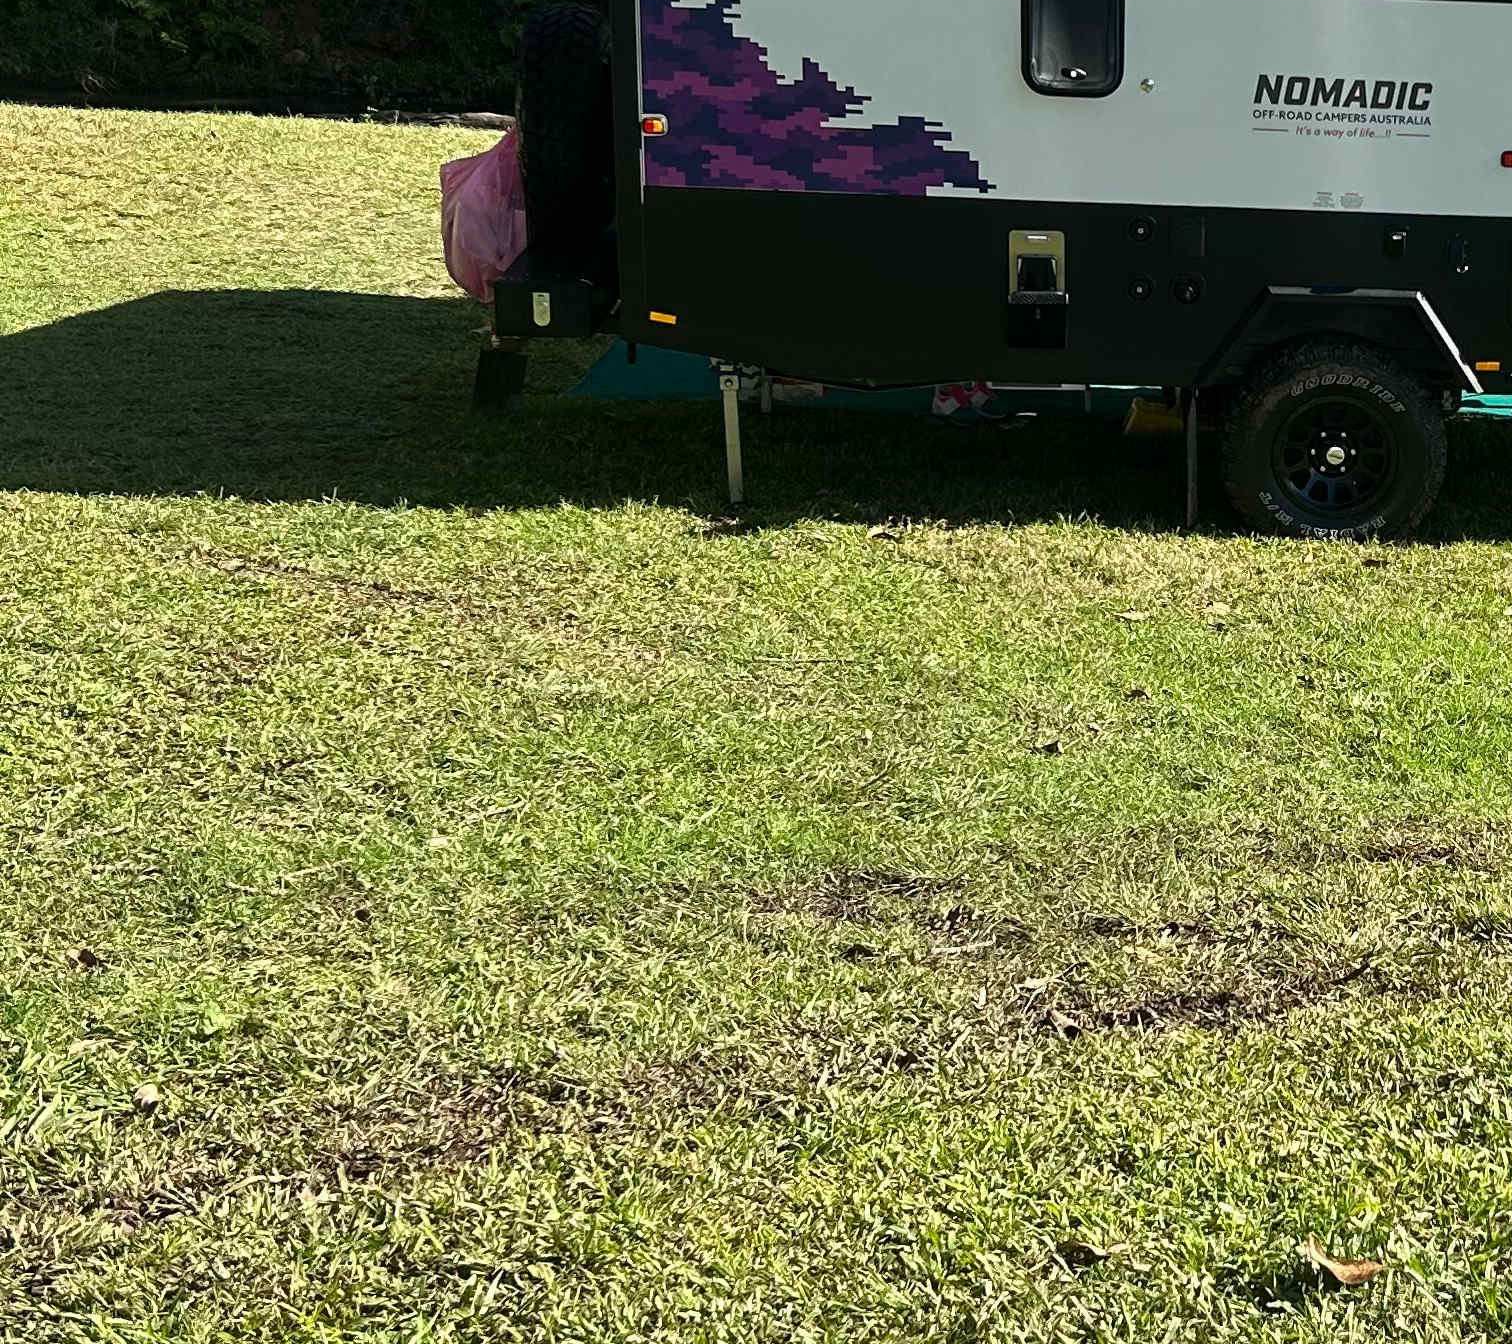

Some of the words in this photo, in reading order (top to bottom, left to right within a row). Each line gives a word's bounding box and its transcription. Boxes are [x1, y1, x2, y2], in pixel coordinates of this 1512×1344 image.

[1253, 74, 1433, 111] NOMADIC
[1252, 109, 1312, 121] OFF-ROAD
[1315, 111, 1367, 123] CAMPERS
[1369, 114, 1432, 126] AUSTRALIA
[1295, 126, 1312, 136] It's
[1323, 129, 1345, 139] way
[1346, 127, 1358, 137] of
[1290, 373, 1407, 413] GOODRIDE
